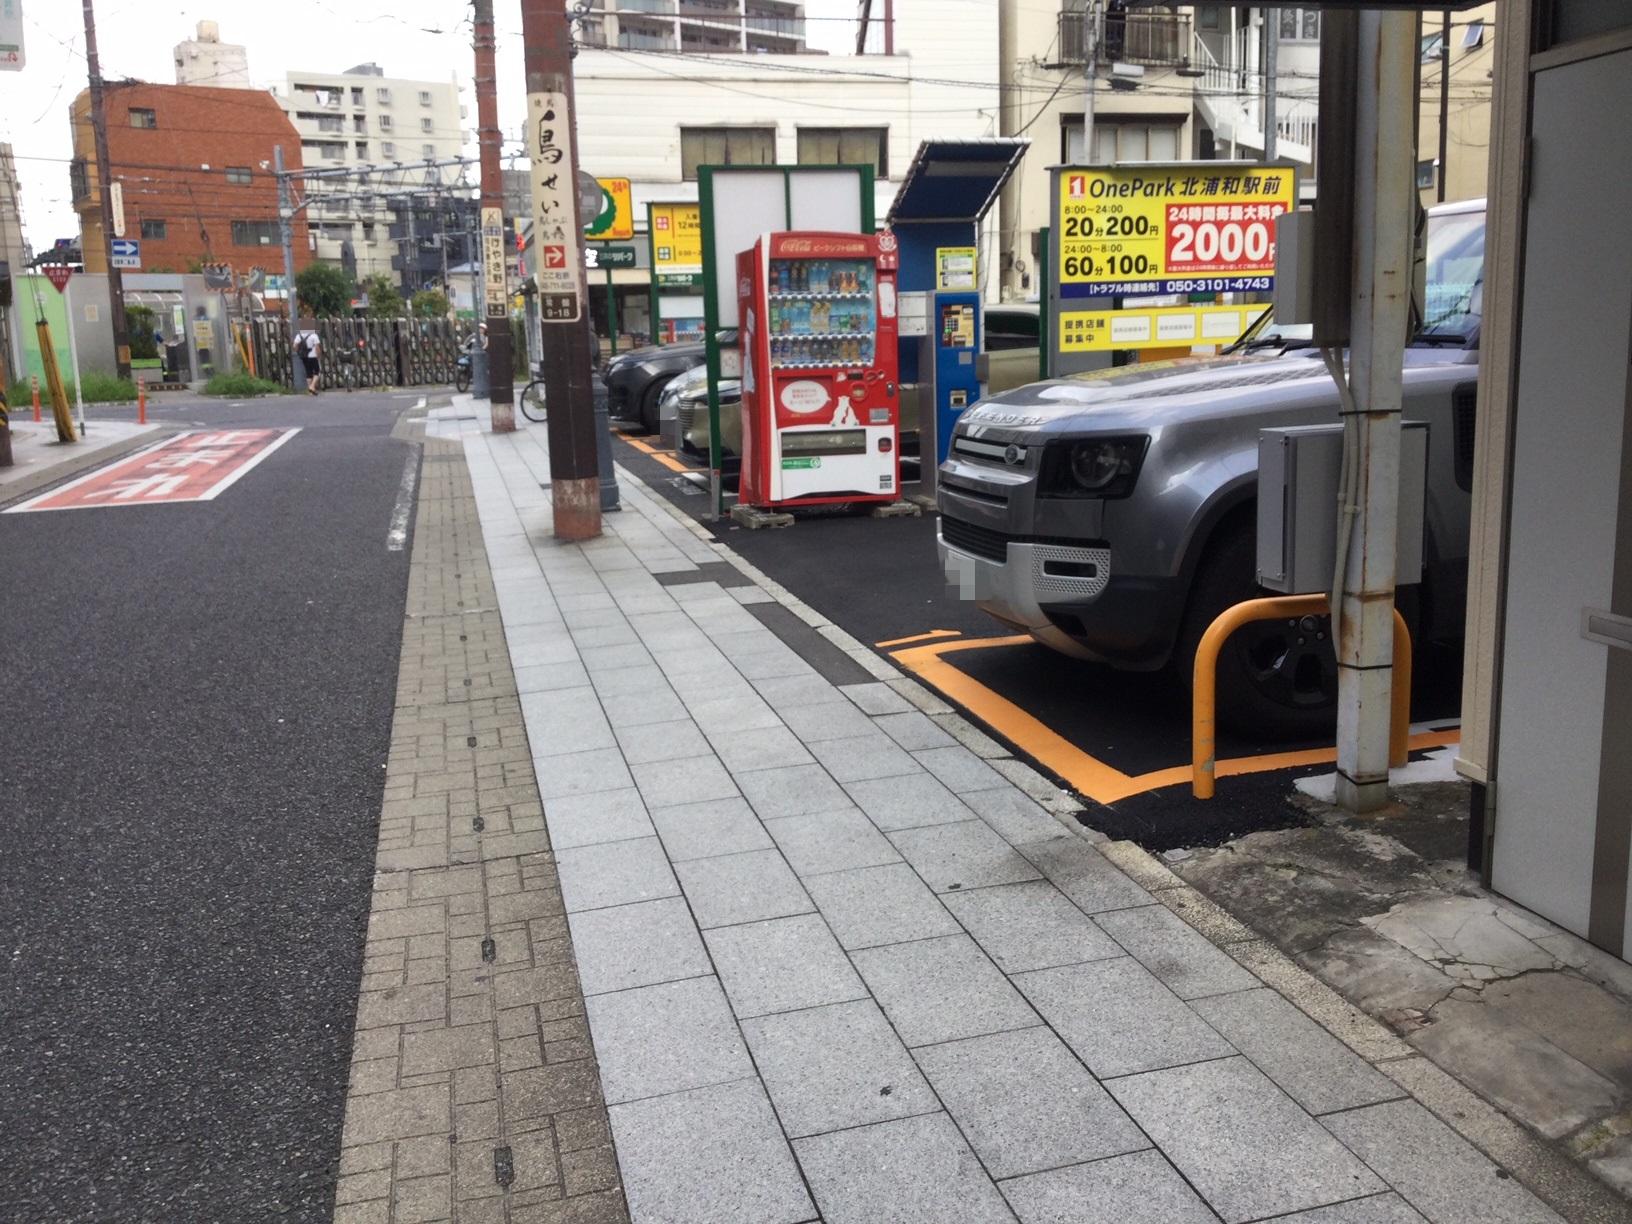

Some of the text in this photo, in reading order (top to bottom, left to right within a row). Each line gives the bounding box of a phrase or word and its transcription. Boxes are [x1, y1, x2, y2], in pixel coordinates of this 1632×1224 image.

[1090, 176, 1282, 198] OnePark 北浦和駅前
[1167, 278, 1269, 292] 050-3101-4743
[1065, 319, 1105, 330] 提携店舗
[1065, 334, 1095, 344] 募集中
